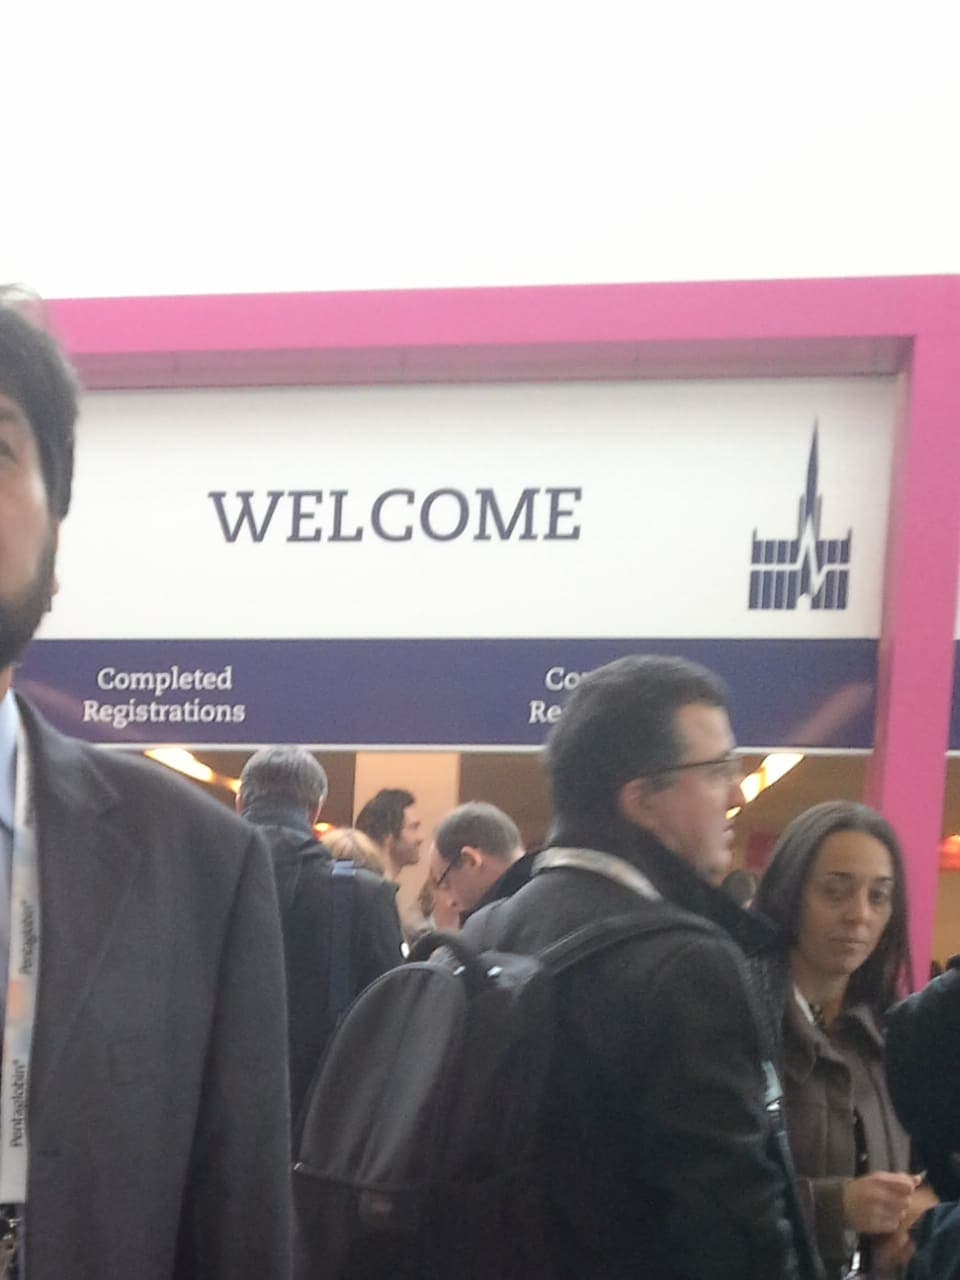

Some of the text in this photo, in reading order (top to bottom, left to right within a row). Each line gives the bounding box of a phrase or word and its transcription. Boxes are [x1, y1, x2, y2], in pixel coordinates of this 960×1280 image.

[208, 487, 583, 542] WELCOME
[97, 665, 232, 696] Completed
[83, 699, 246, 728] Registrations
